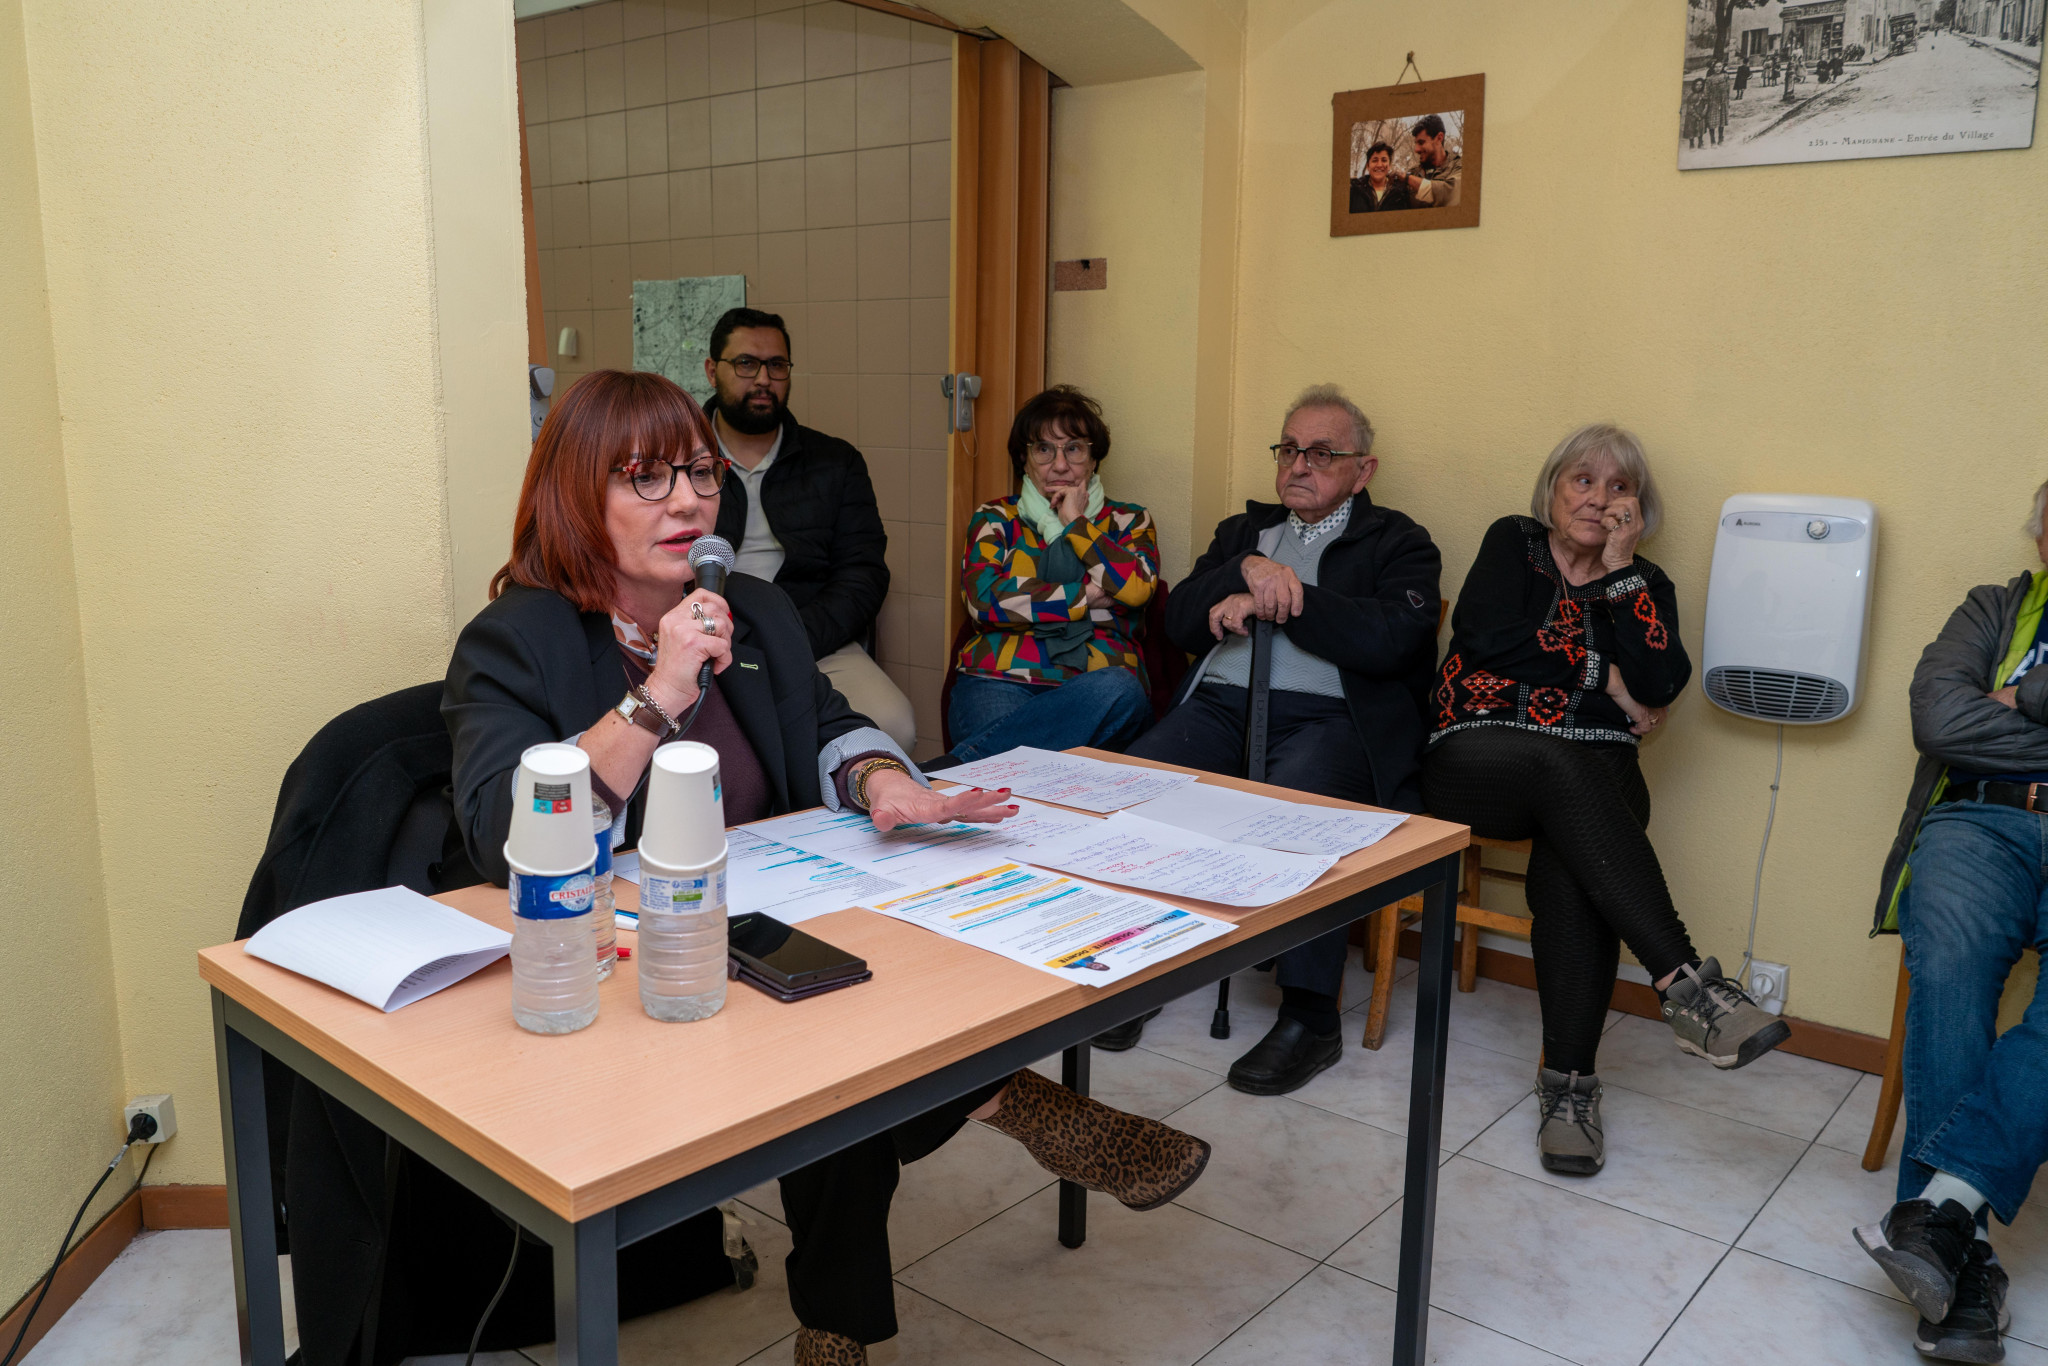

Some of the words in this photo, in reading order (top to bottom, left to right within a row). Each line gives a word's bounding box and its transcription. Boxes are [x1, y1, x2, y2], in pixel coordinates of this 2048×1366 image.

[1906, 133, 1939, 142] Entrée
[1942, 132, 1955, 140] du
[1960, 130, 1995, 141] Village
